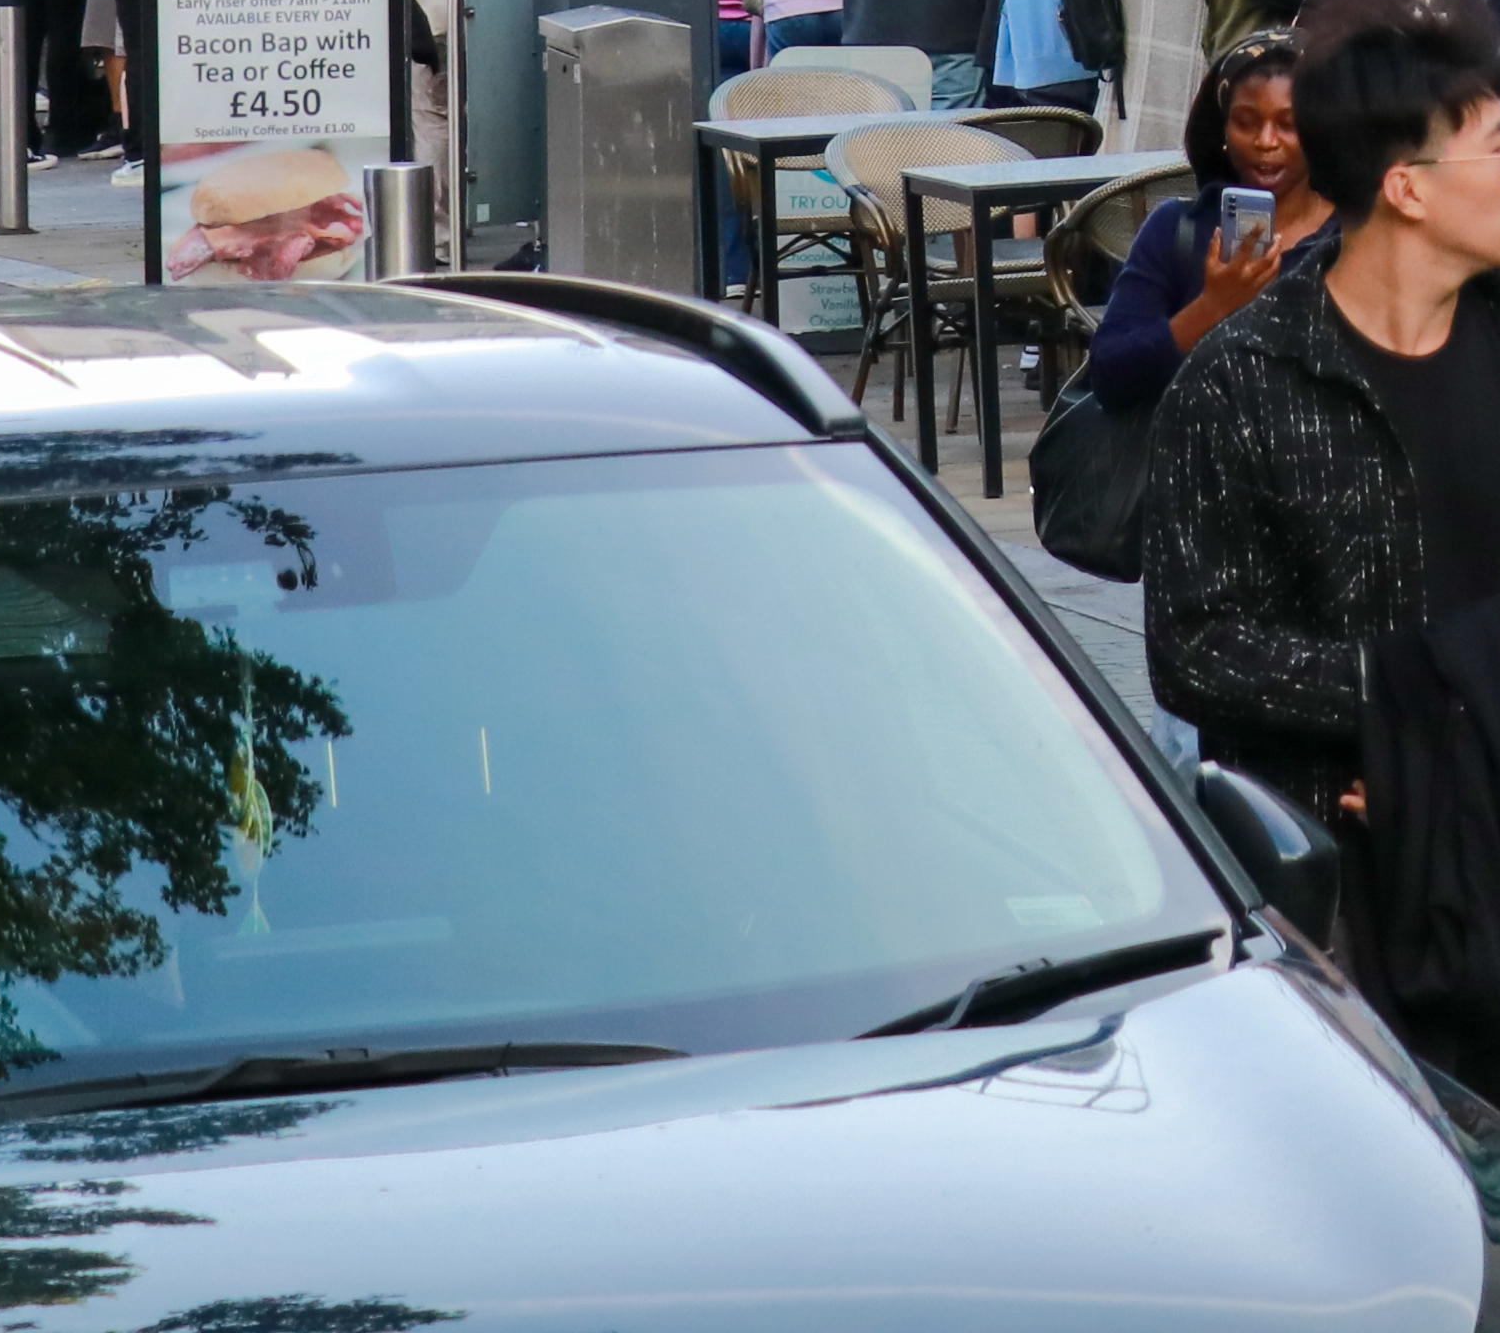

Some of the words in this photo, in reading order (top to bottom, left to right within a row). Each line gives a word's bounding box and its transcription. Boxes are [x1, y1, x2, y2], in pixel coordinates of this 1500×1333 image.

[196, 10, 272, 26] AVAILABLE
[276, 9, 320, 24] EVERY
[324, 9, 352, 23] DAY
[177, 33, 253, 55] Bacon
[261, 32, 308, 57] Bap
[316, 29, 371, 51] with
[193, 62, 234, 83] Tea
[243, 64, 268, 82] or
[277, 58, 356, 80] Coffee
[229, 88, 321, 119] £4.50
[194, 124, 250, 139] Speciality
[252, 123, 288, 136] Coffee
[292, 122, 321, 135] Extra
[324, 122, 356, 135] £1.00
[789, 195, 818, 209] TRY
[821, 195, 849, 209] OU
[809, 282, 857, 295] Strawbe
[809, 314, 863, 327] Chocola
